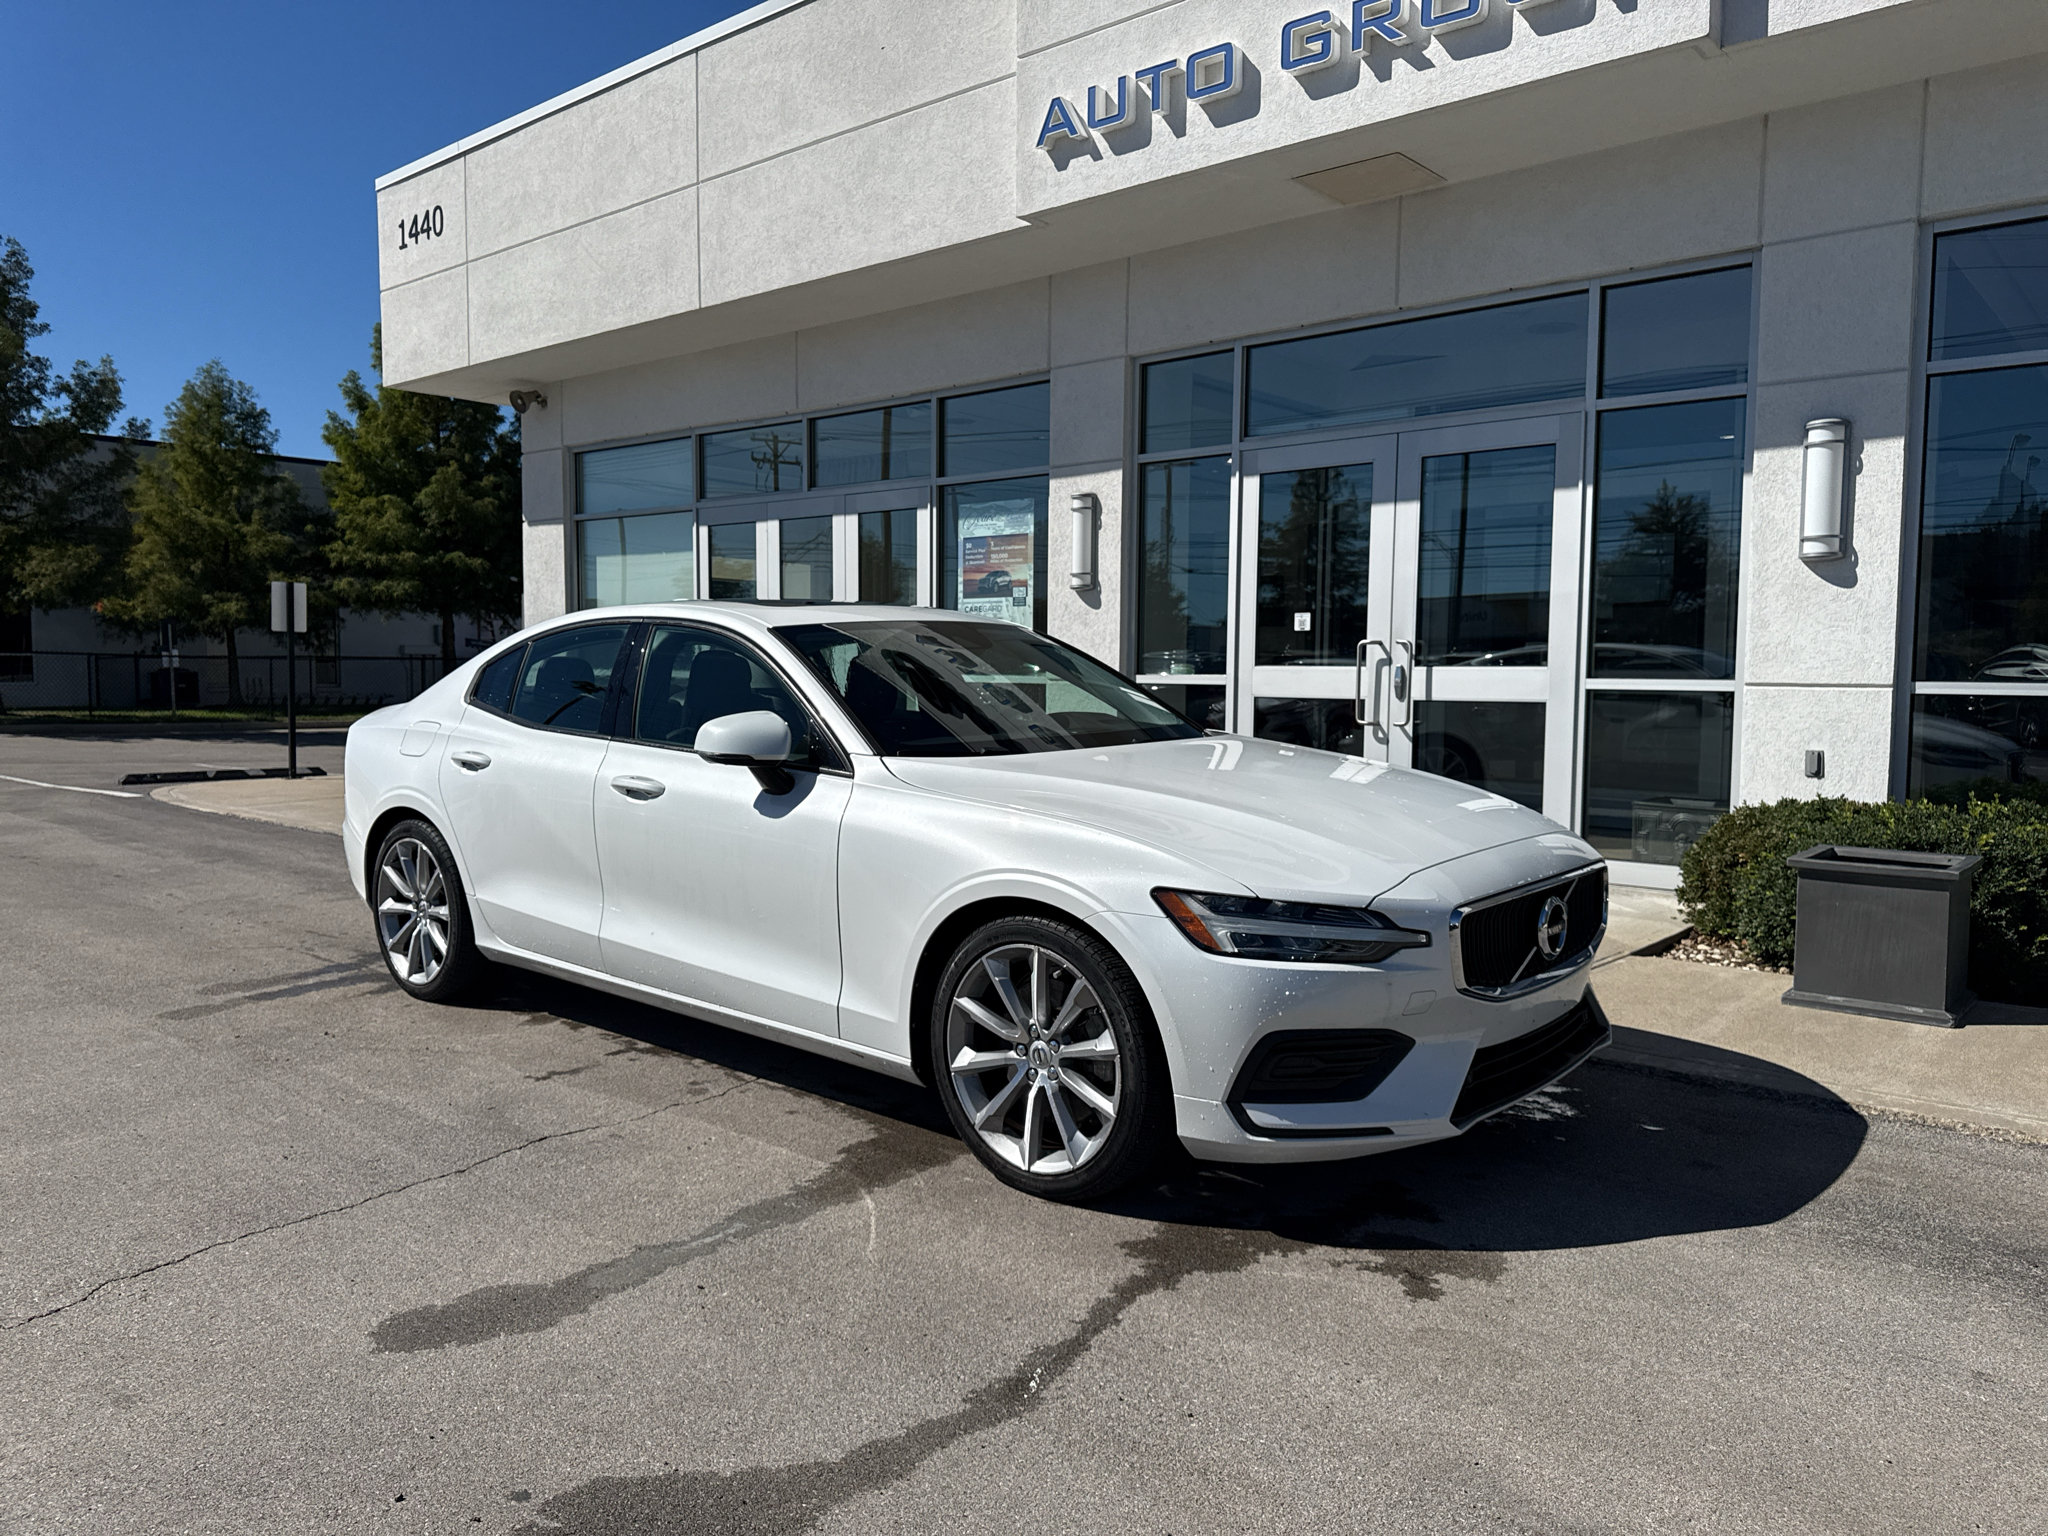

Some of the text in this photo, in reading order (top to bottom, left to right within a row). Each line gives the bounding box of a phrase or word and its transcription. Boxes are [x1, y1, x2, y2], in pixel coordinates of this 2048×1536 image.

[1036, 0, 1524, 149] AUTO GR
[398, 205, 443, 250] 1440
